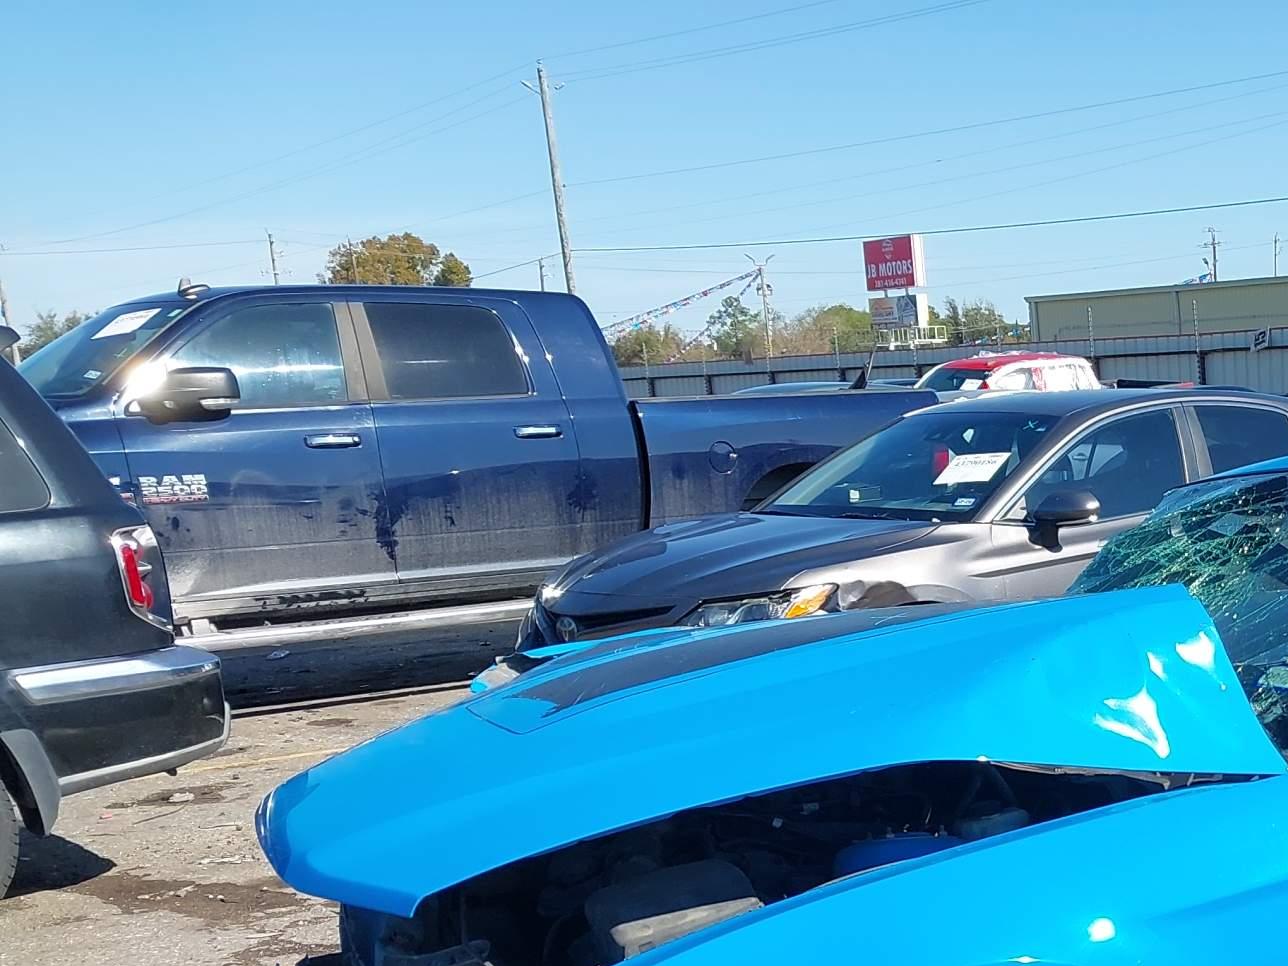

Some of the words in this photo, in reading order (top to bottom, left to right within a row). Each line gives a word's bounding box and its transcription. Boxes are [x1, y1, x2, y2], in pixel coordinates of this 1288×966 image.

[879, 260, 912, 277] MOTORS
[138, 474, 207, 487] RAM
[141, 485, 208, 497] 2500
